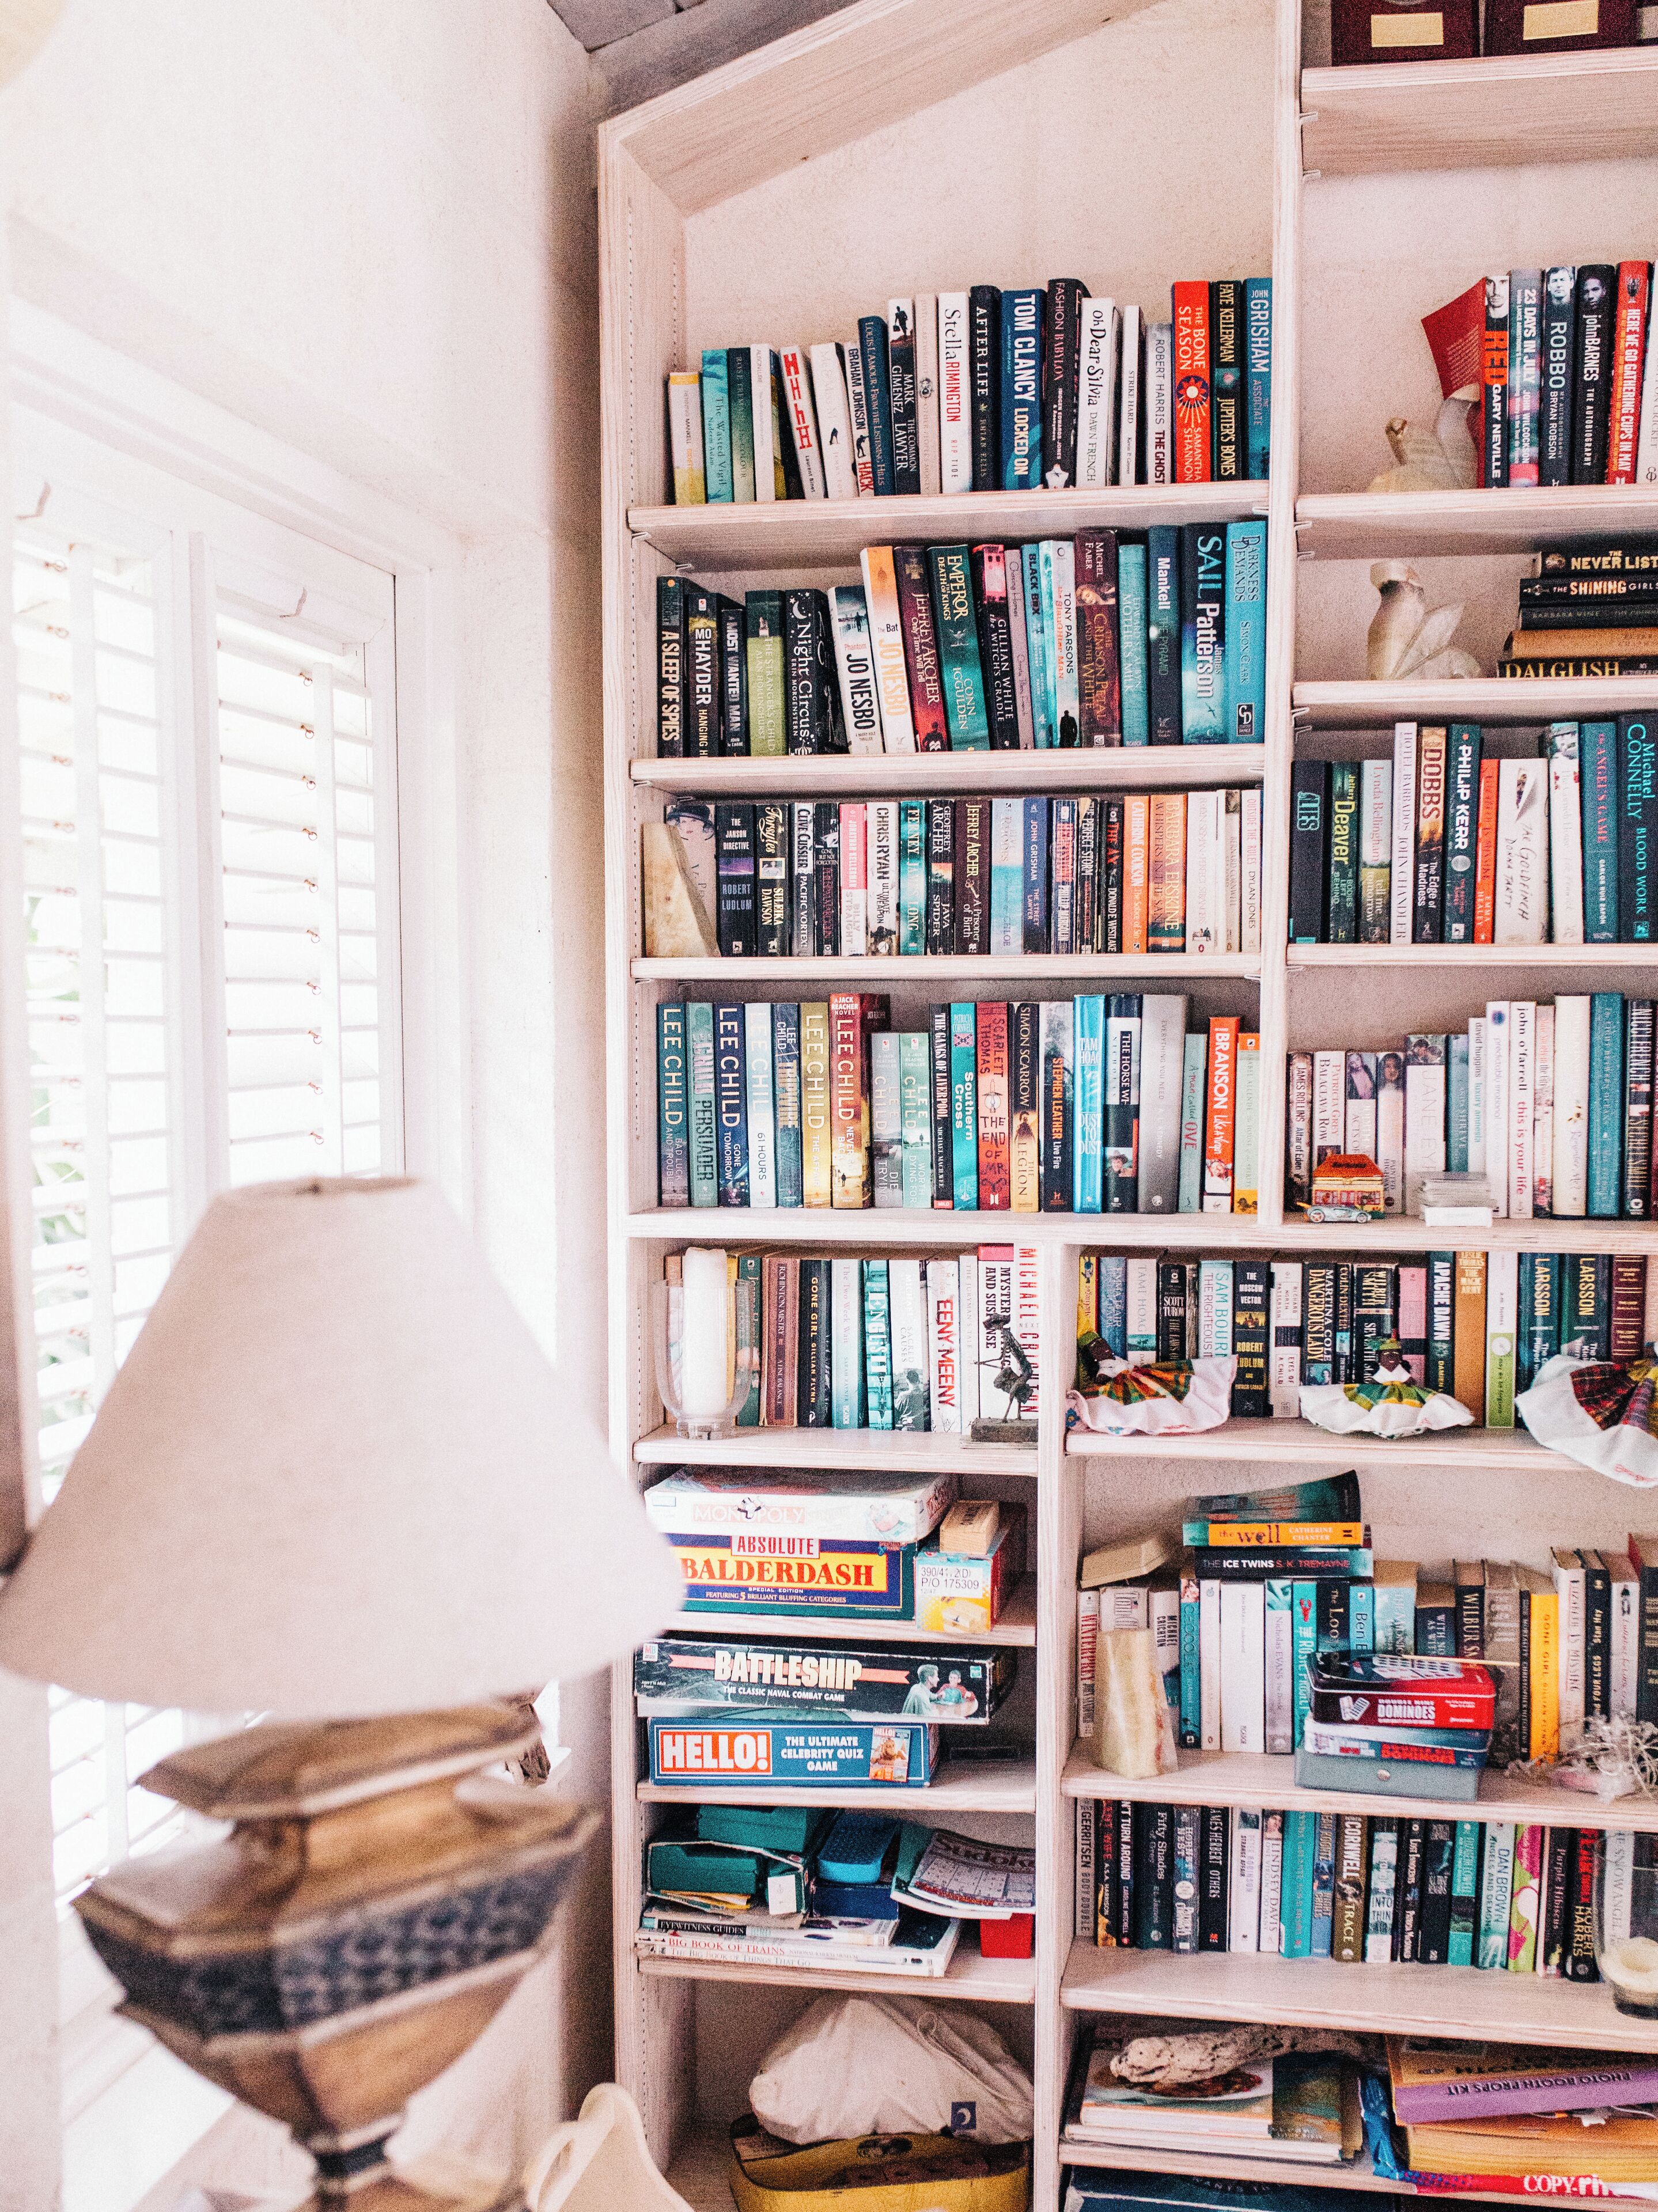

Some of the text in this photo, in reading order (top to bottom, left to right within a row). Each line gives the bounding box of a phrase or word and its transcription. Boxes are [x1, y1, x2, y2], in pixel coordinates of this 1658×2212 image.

[944, 309, 962, 422] Stella RIMINGTON
[976, 306, 988, 396] AFTER LIFE
[1087, 310, 1107, 406] Oh Dear Silvia
[1179, 306, 1192, 370] SEASON
[1193, 329, 1205, 369] BONE
[1251, 300, 1269, 372] GRISHAM
[1523, 289, 1536, 384] 23 DAYS IN JULY
[1549, 322, 1567, 388] ROBBO
[892, 366, 903, 414] GIMENEZ
[904, 374, 914, 403] MARK
[1014, 295, 1035, 475] TOM CLANCY LOCKED ON
[1155, 339, 1165, 483] ROBERT HARRIS THE GHOST
[1217, 284, 1235, 476] FAYE KELLERMAN JUPITER'S BONES
[1485, 331, 1508, 478] RED GARY NEVILLE
[848, 348, 874, 491] GRAHAM JOHNSON HACK
[895, 423, 907, 471] LAWYER
[1184, 428, 1193, 481] SHANNON
[1194, 427, 1202, 480] SAMANTHA
[947, 555, 968, 621] EMPEROR
[1085, 543, 1093, 569] FABER
[1157, 558, 1169, 609] Mankell
[1197, 536, 1222, 599] SAIL
[1570, 581, 1626, 595] SHINING
[1571, 557, 1623, 570] NEVER
[912, 593, 939, 704] JEFFREY ARCHER
[1065, 593, 1074, 673] TONY PARSONS
[1196, 603, 1219, 698] Patterson
[662, 631, 679, 740] A SLEEP OF SPIES
[695, 640, 711, 704] HAYDER
[793, 623, 813, 737] Night Circus
[846, 654, 876, 729] JO NESBO
[1422, 748, 1443, 819] DOBBS
[1454, 745, 1470, 850] PHILIP KERR
[1626, 724, 1644, 819] CONNELLY
[759, 807, 783, 853] Forsytes
[797, 809, 811, 869] CLIVE CUSSLER
[876, 808, 890, 880] CHRIS RYAN
[932, 805, 943, 853] ARCHER
[942, 806, 951, 853] GEOFFREY
[966, 804, 982, 877] JEFFREY ARCHER
[1333, 801, 1355, 865] Deaver
[1164, 802, 1180, 930] BARBARA ERSKINE
[1636, 828, 1647, 914] BLOOD WORK
[762, 889, 773, 925] DAWSON
[774, 888, 783, 925] SULEIKA
[664, 1007, 682, 1126] LEE CHILD
[718, 1007, 740, 1127] LEE CHILD
[837, 1020, 854, 1120] LEE CHILD
[1019, 1007, 1031, 1106] SIMON SCARROW
[1213, 1032, 1229, 1109] BRANSON
[955, 1084, 964, 1128] Cross
[964, 1072, 974, 1140] Southern
[1051, 1058, 1063, 1169] STEPHEN LEATHER Live Fire
[1296, 1066, 1307, 1122] JAMES ROLLINS
[1513, 1007, 1528, 1195] john o'farrell this is your life
[695, 1100, 714, 1181] PERSUADER
[724, 1131, 733, 1180] TOMORROW
[733, 1144, 741, 1167] GONE
[757, 1132, 767, 1180] 61 HOURS
[1017, 1142, 1027, 1195] LEGION
[810, 1277, 818, 1338] GONE GIRL
[1307, 1269, 1324, 1360] DANGEROUS LADY
[1323, 1269, 1333, 1361] MARTINA COLE
[1433, 1262, 1451, 1340] APACHE DAWN
[1534, 1258, 1550, 1316] LARSSON
[1578, 1257, 1595, 1315] LARSSON
[736, 1535, 815, 1555] ABSOLUTE
[1223, 1560, 1274, 1569] ICE TWINS
[1237, 1524, 1280, 1544] well
[681, 1559, 873, 1586] BALDERDASH
[921, 1577, 979, 1589] P/O 175309
[715, 1650, 863, 1690] BATTLESHIP
[724, 1685, 845, 1702] THE CLASSIC NAVAL COMBAT GAME
[785, 1736, 858, 1748] THE ULTIMATE
[1377, 1704, 1436, 1719] DOMINOES
[664, 1734, 768, 1770] HELLO!
[781, 1748, 864, 1760] CELEBRITY QUIZ
[807, 1759, 838, 1772] GAME
[1081, 1812, 1092, 1868] GERRITSEN
[1156, 1812, 1167, 1879] Fifty Shades
[1342, 1821, 1361, 1942] CORNWELL TRACE
[1494, 1849, 1510, 1923] DAN BROWN
[660, 1921, 744, 1934] EYEWITNESS GUIDES
